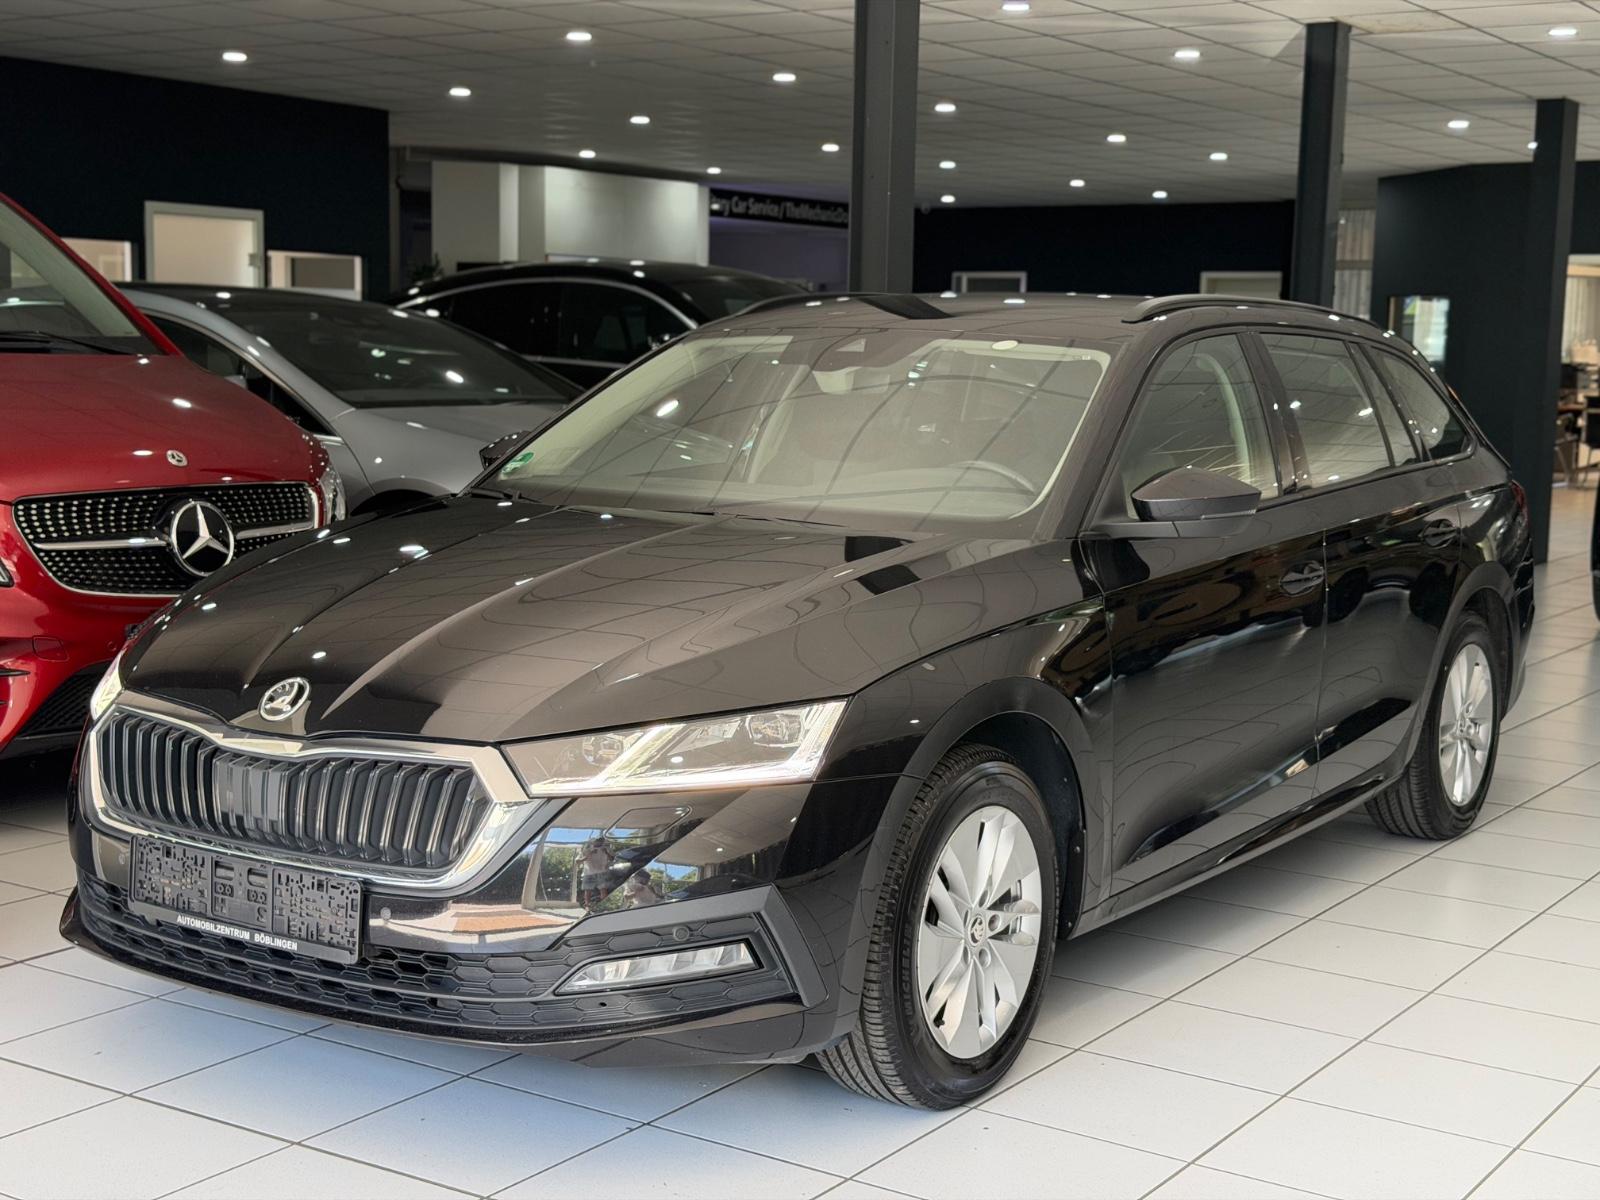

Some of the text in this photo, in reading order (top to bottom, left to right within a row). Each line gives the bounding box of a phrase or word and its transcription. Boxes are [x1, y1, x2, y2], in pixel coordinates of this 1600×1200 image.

[731, 195, 748, 214] Car
[748, 197, 780, 217] Service
[176, 915, 298, 951] AUTOMOBILZENTRUM BÖBLINGEN
[901, 922, 914, 1016] MICHELIN
